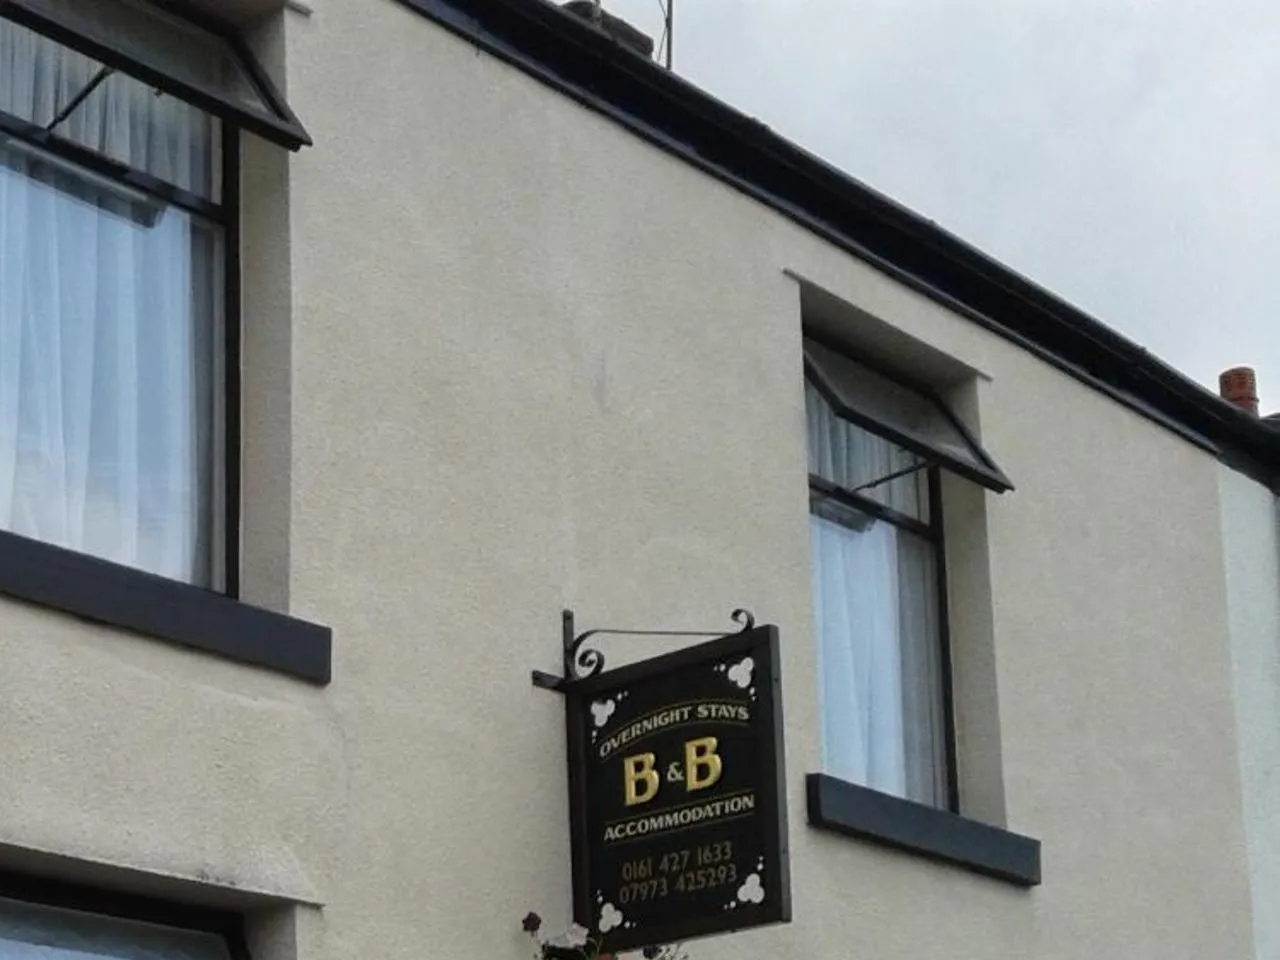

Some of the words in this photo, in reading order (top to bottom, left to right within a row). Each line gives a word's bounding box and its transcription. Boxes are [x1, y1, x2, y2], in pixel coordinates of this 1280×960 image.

[599, 705, 691, 758] OVERNIGHT
[696, 703, 750, 721] STAYS
[604, 794, 755, 841] ACCOMMODATION
[622, 857, 653, 881] 0161
[659, 850, 691, 873] 427
[697, 840, 732, 865] 1633
[619, 877, 668, 904] 07973
[674, 863, 738, 892] 425293
